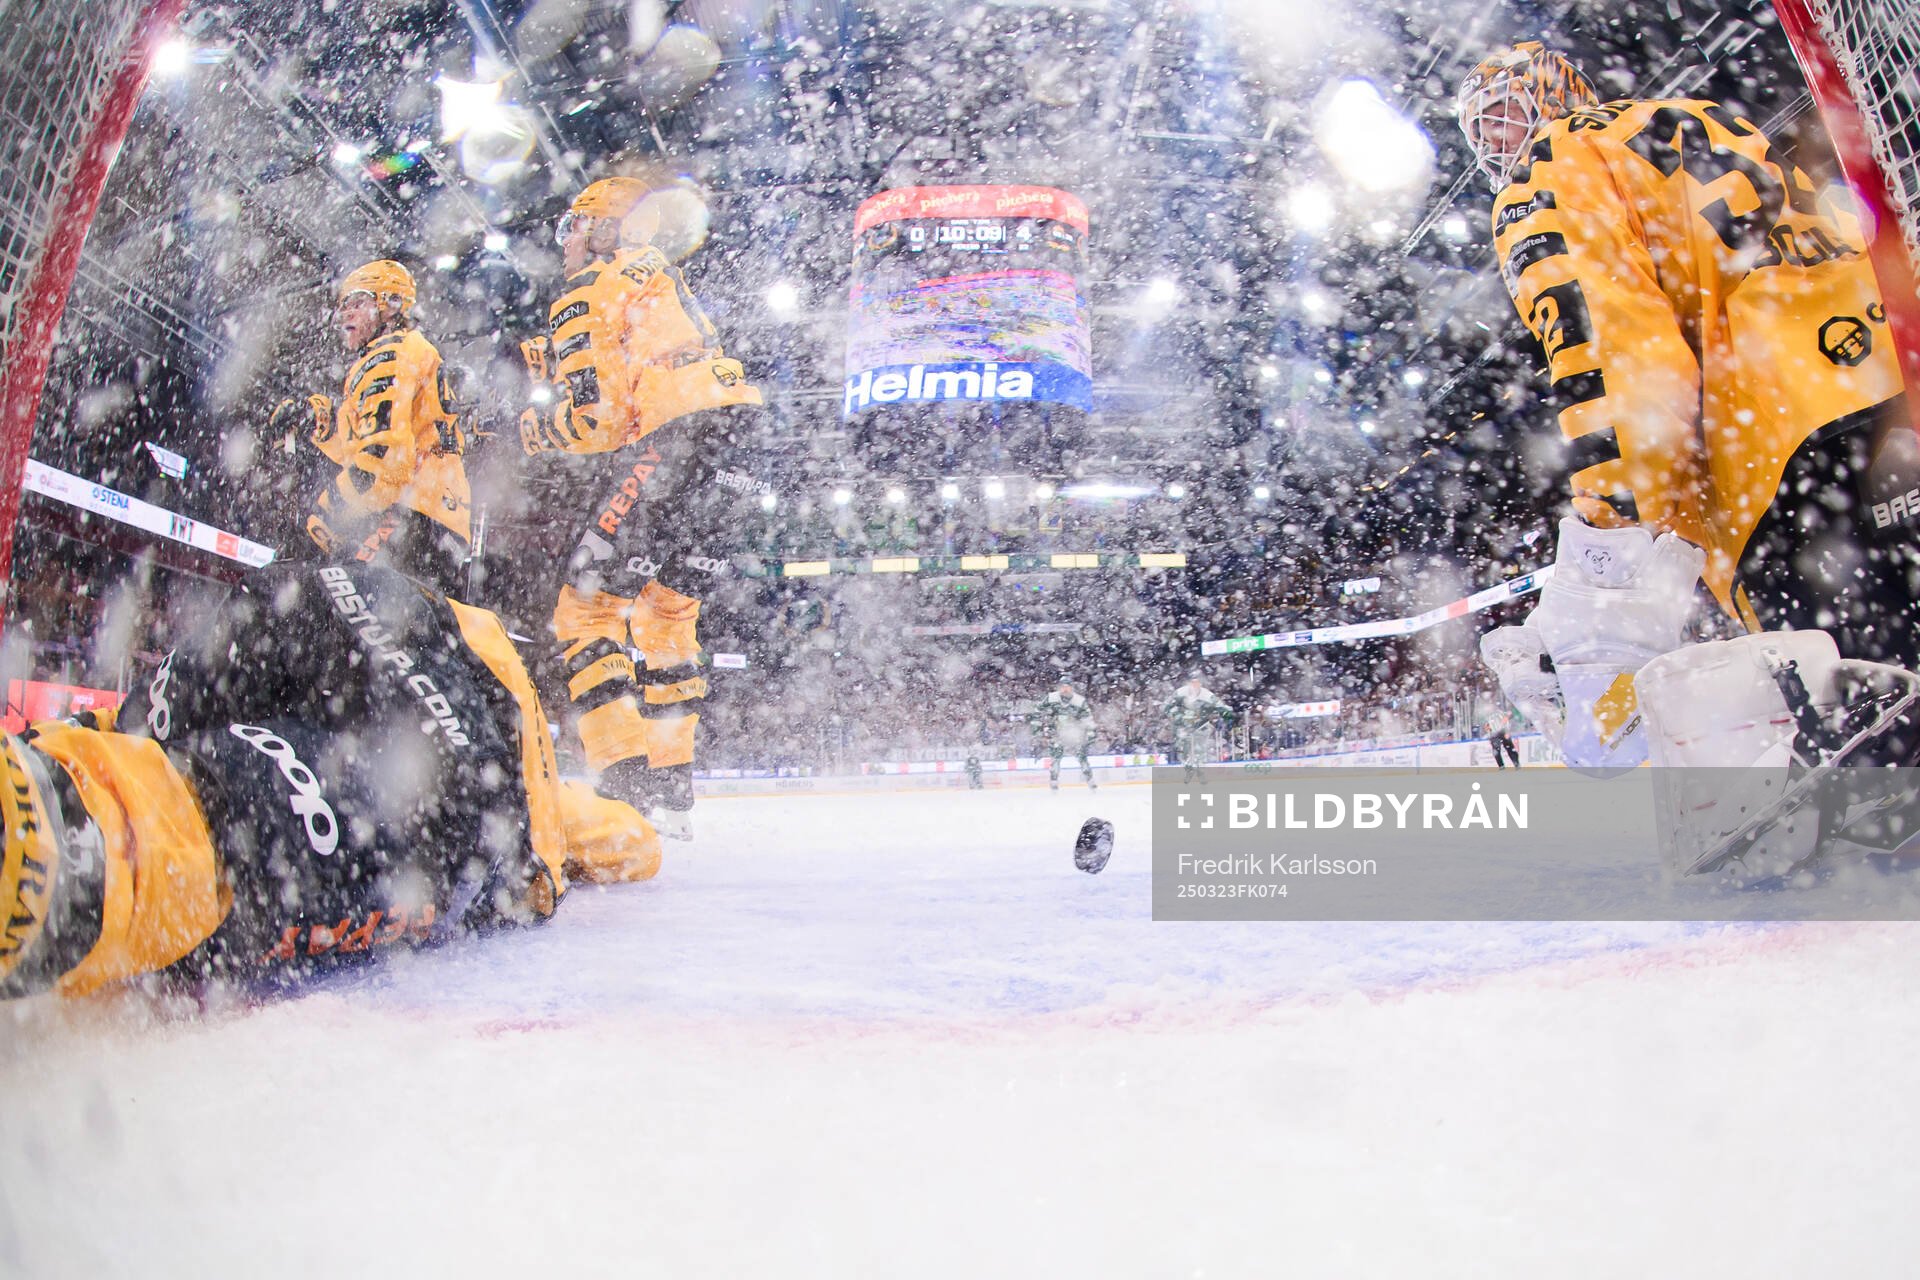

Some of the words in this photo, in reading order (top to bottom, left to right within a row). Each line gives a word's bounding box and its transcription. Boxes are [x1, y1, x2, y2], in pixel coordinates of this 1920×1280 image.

[996, 192, 1054, 211] pitchers
[910, 227, 925, 242] 0
[938, 226, 1002, 242] 10:09
[1015, 226, 1032, 242] 4
[844, 363, 1033, 416] Helmia
[100, 489, 129, 510] STENA
[597, 446, 662, 536] REPAY
